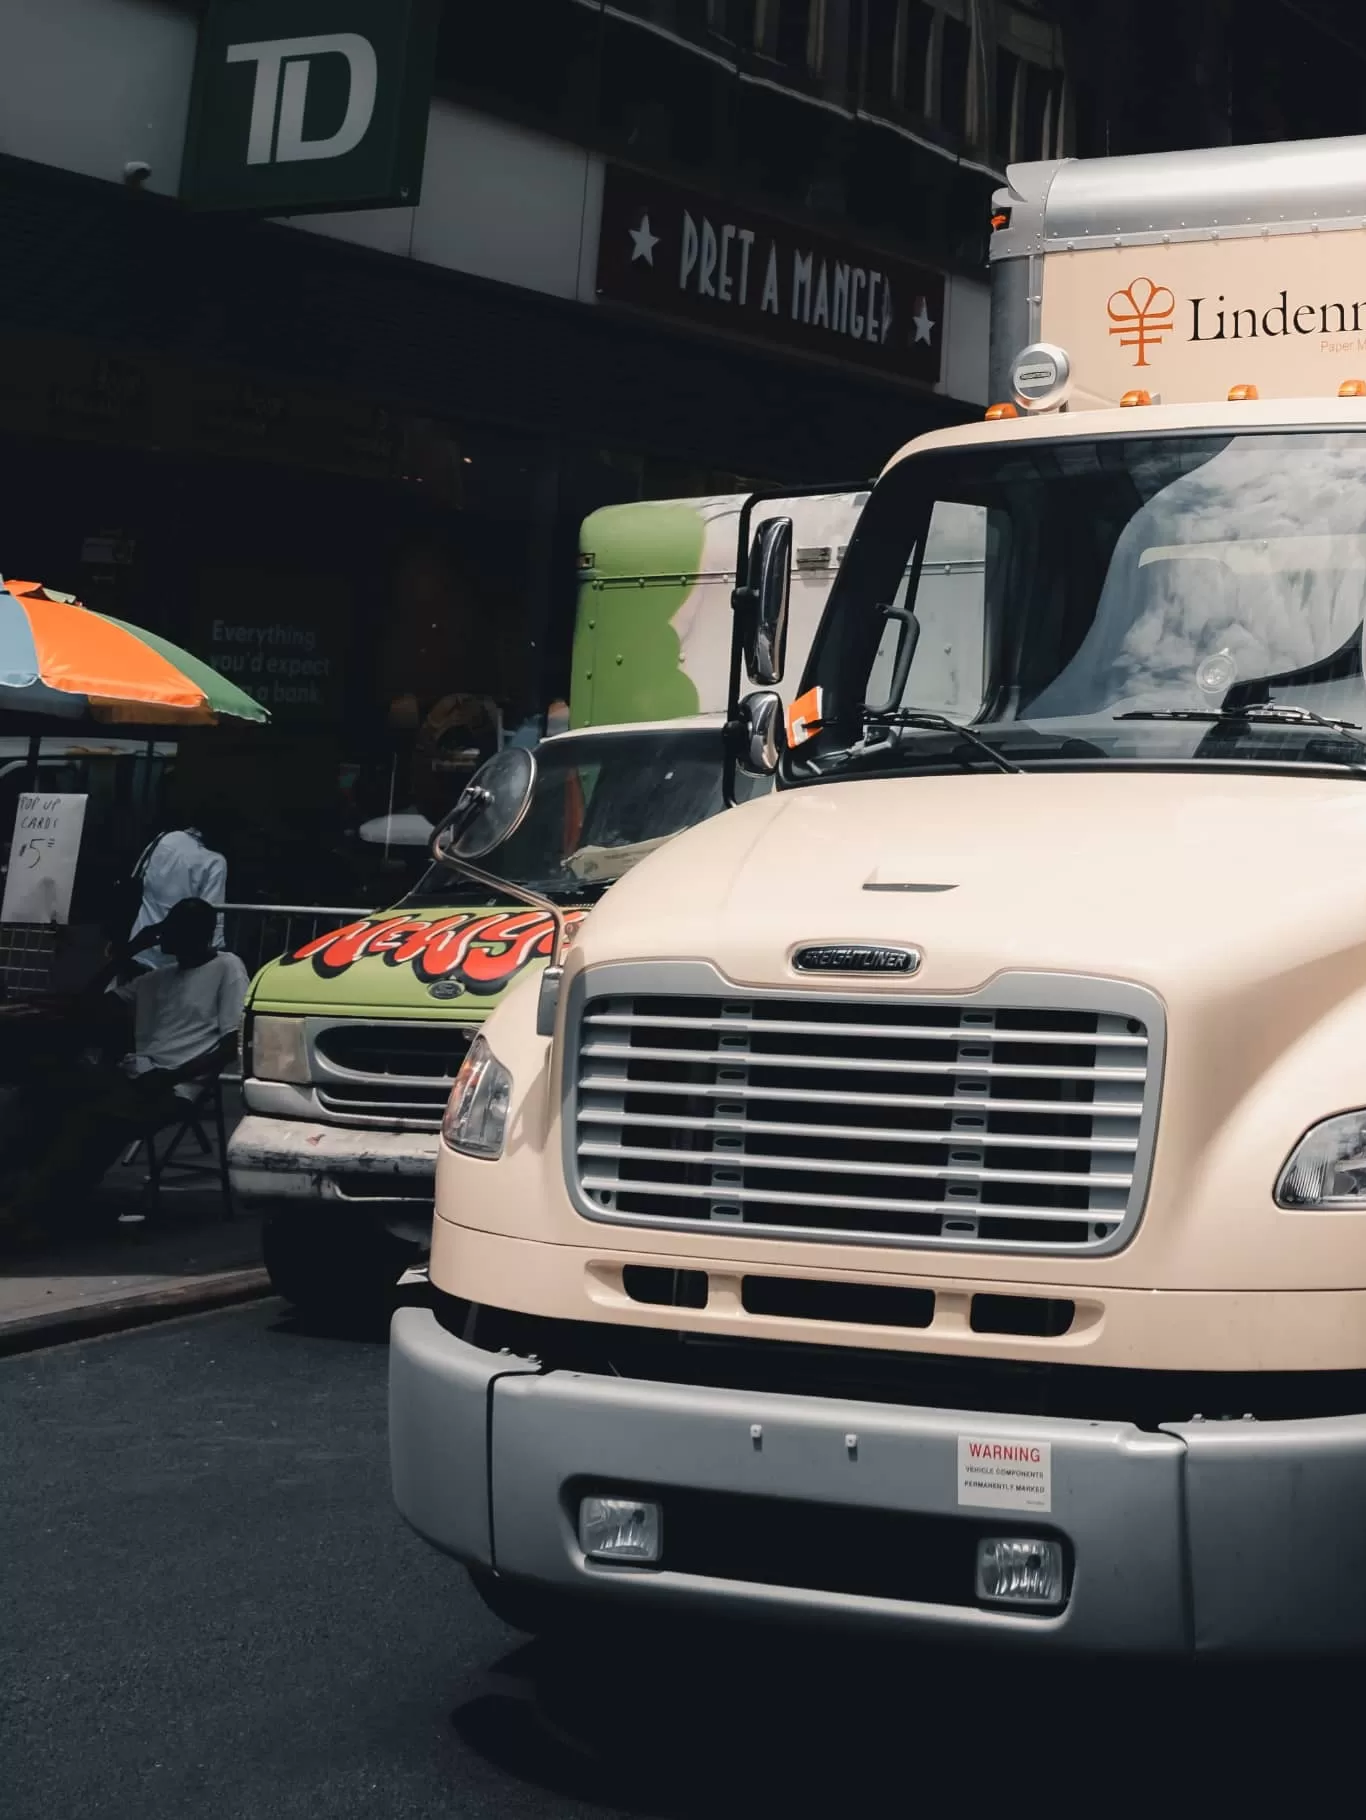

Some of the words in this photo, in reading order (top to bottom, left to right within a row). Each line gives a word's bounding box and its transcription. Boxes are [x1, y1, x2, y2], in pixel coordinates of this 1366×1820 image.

[226, 32, 379, 166] TD
[679, 208, 756, 306] PRET
[760, 239, 779, 315] A
[791, 247, 893, 345] MANGER
[1320, 340, 1353, 353] Paper
[211, 619, 317, 652] Everything
[266, 657, 331, 679] expect
[803, 948, 907, 968] FREIGHTLINER
[969, 1443, 1041, 1462] WARNING
[966, 1466, 995, 1474] VEHICLE
[997, 1469, 1044, 1478] COMPONENTS
[965, 1480, 1014, 1489] PERMANENTLY
[1016, 1485, 1045, 1493] MARKED
